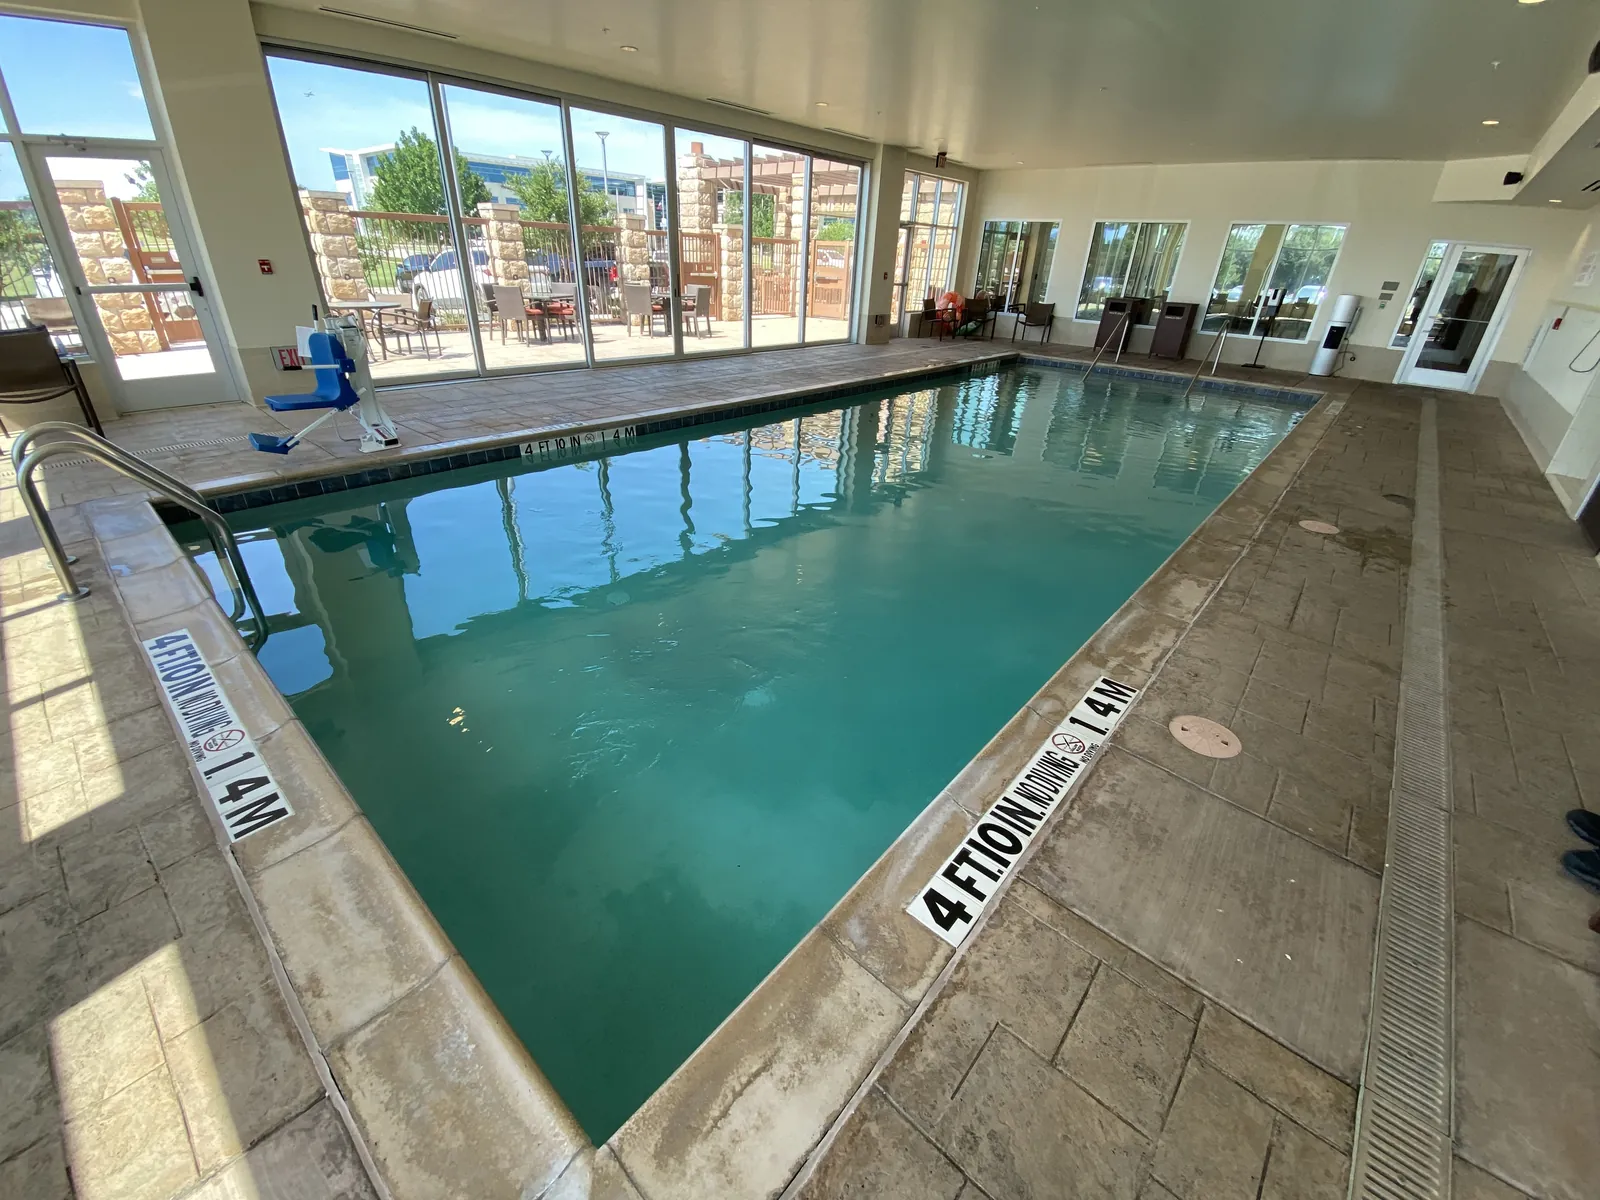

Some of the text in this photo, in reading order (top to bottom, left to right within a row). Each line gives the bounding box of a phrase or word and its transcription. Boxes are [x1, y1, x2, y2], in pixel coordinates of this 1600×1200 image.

[525, 443, 533, 454] 4
[538, 440, 550, 452] FT
[555, 438, 566, 450] 10
[570, 435, 581, 447] IN
[149, 634, 189, 650] 4
[182, 700, 233, 738] DIVING
[922, 887, 974, 932] 4
[1024, 750, 1080, 795] DIVING
